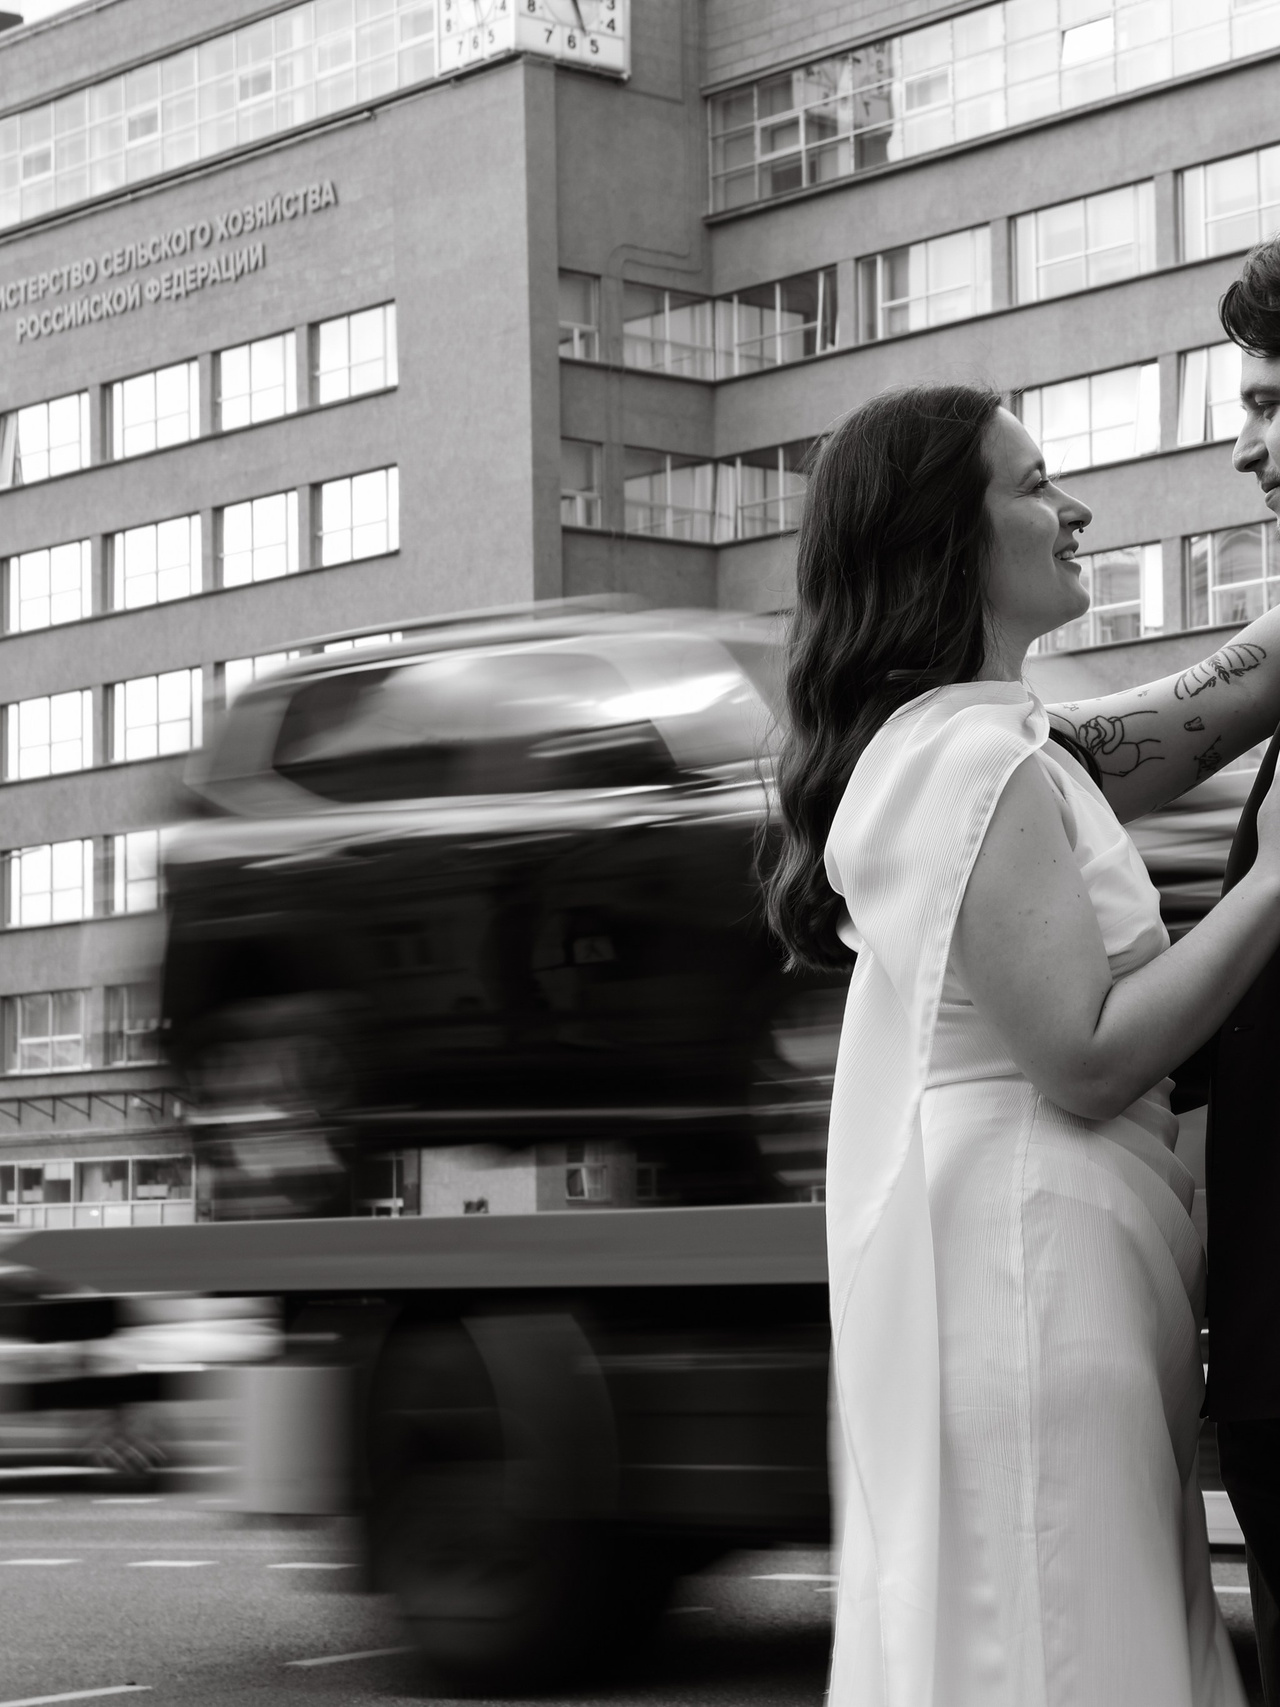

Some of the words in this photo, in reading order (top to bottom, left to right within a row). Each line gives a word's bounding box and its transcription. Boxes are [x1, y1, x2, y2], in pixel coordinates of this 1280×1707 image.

[527, 0, 536, 13] 8
[606, 18, 615, 32] 4
[472, 35, 479, 50] 6
[488, 29, 495, 44] 5
[544, 28, 553, 44] 7
[567, 34, 576, 49] 6
[590, 39, 599, 54] 5
[101, 221, 212, 277] СЕЛЬСКОГО
[216, 180, 338, 241] ХОЗЯЙСТВА
[16, 279, 142, 342] РОССИЙСКОЙ
[145, 242, 265, 301] ФЕДЕРАЦИИ
